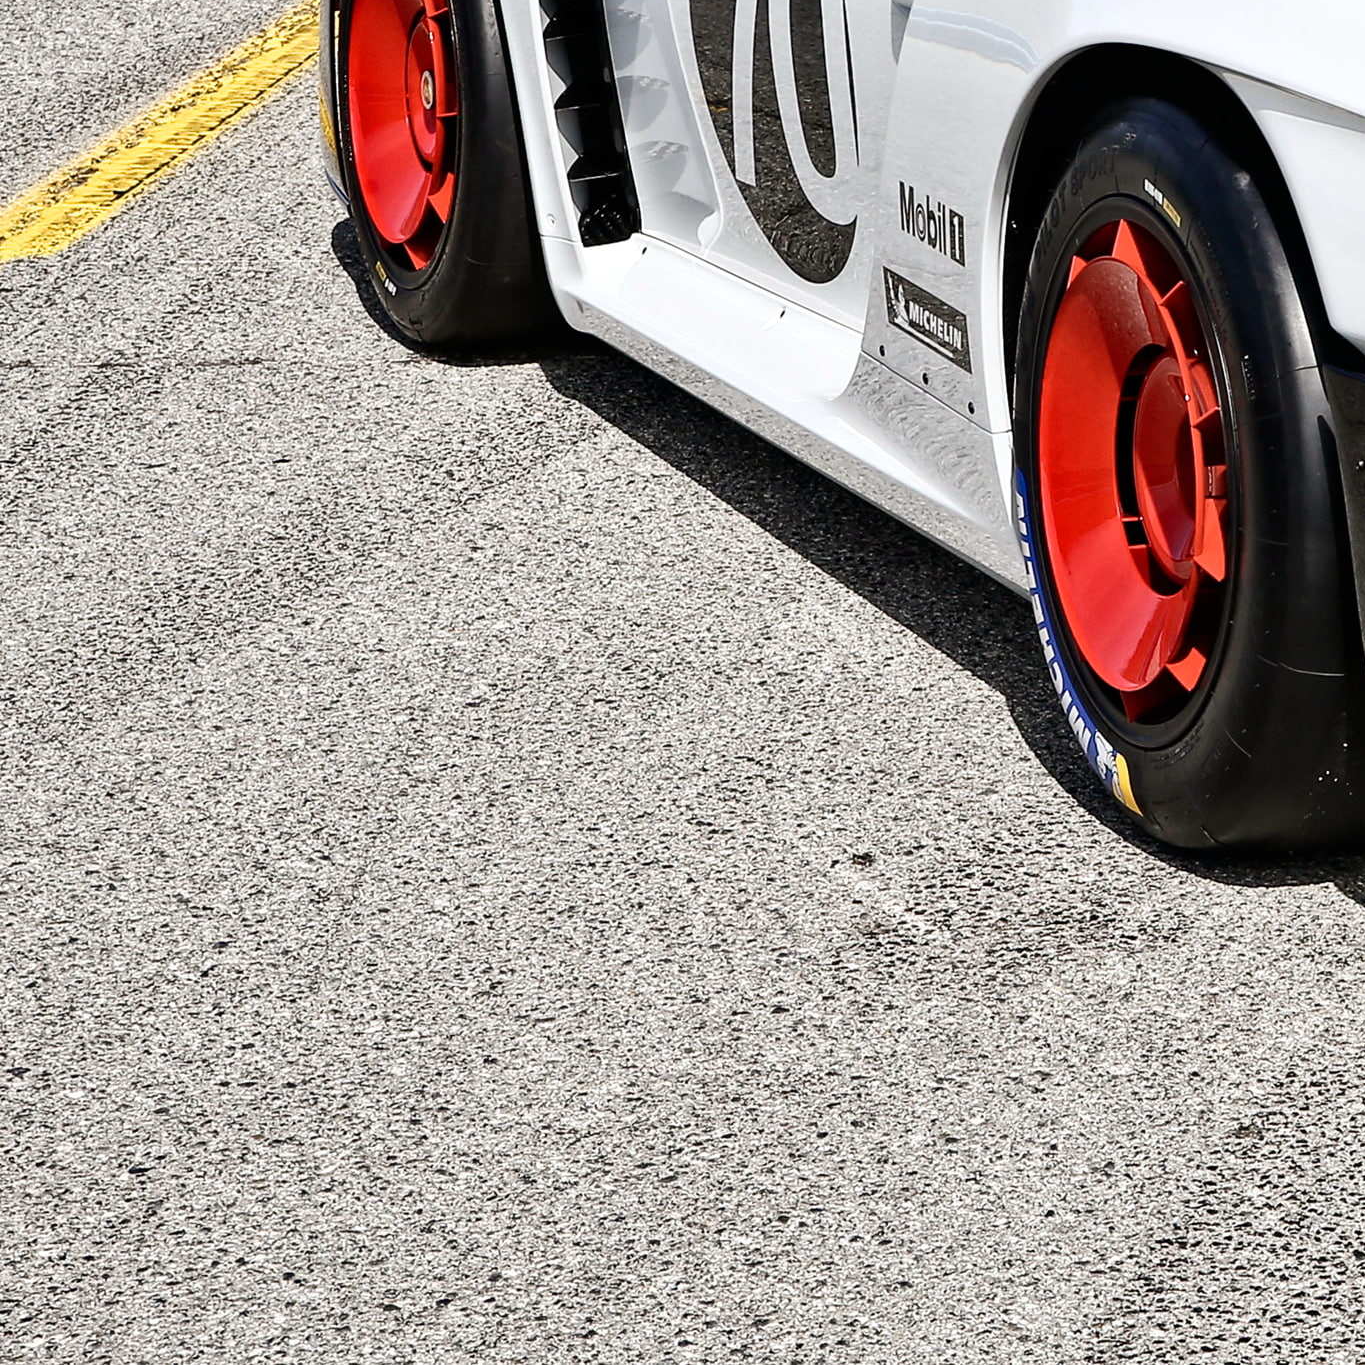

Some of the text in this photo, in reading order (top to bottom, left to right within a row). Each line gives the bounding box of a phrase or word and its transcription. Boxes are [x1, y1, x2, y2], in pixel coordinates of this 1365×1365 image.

[899, 180, 965, 265] Mobil 1
[908, 300, 963, 351] MICHELIN
